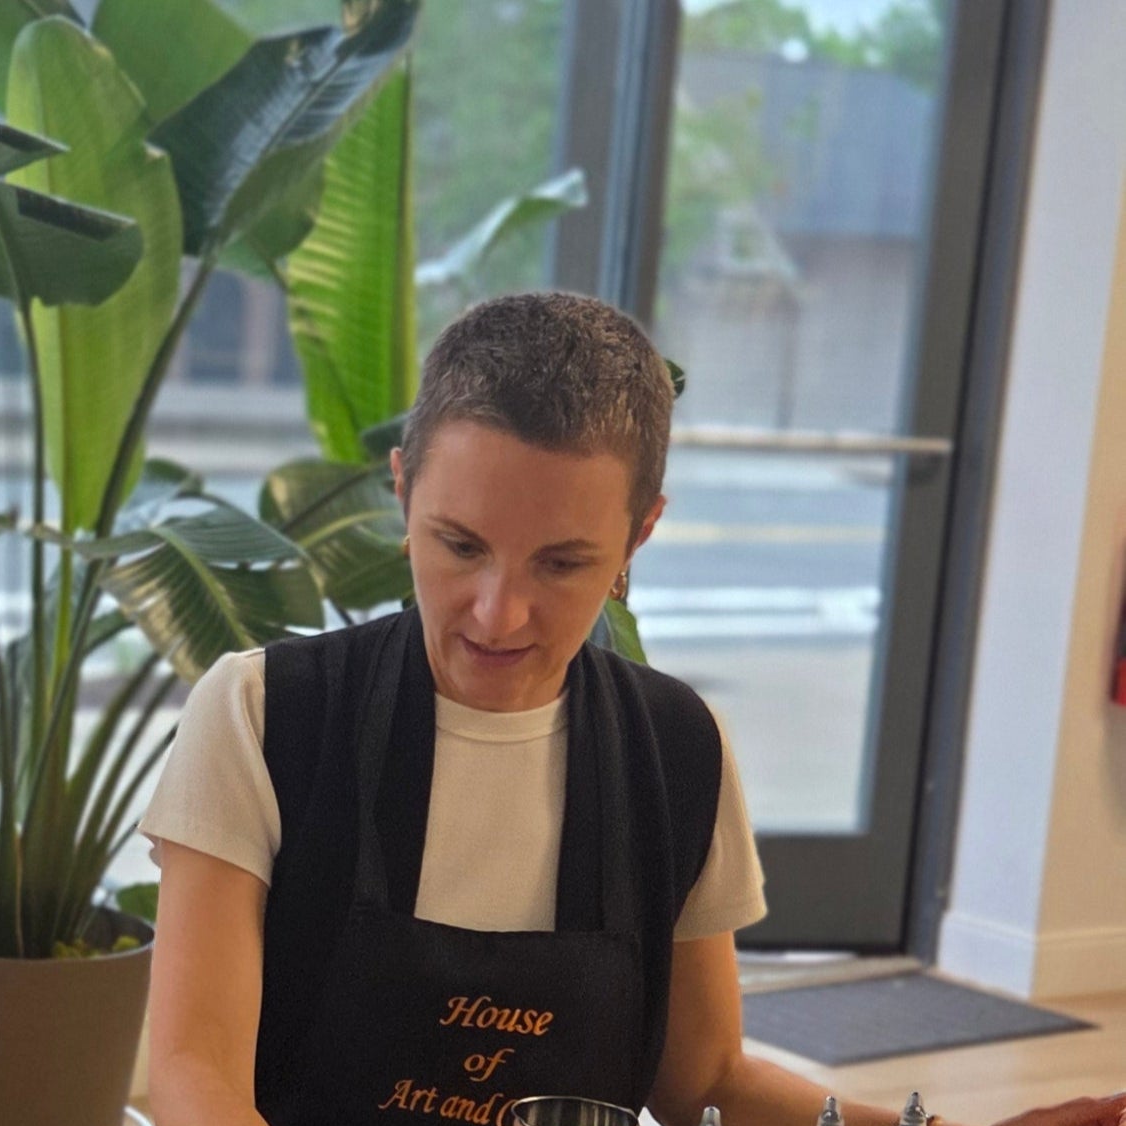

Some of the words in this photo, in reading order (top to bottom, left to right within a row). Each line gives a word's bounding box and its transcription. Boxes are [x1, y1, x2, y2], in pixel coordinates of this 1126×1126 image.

[440, 996, 555, 1036] House
[464, 1049, 515, 1081] of
[379, 1080, 437, 1114] Art
[440, 1093, 504, 1126] and
